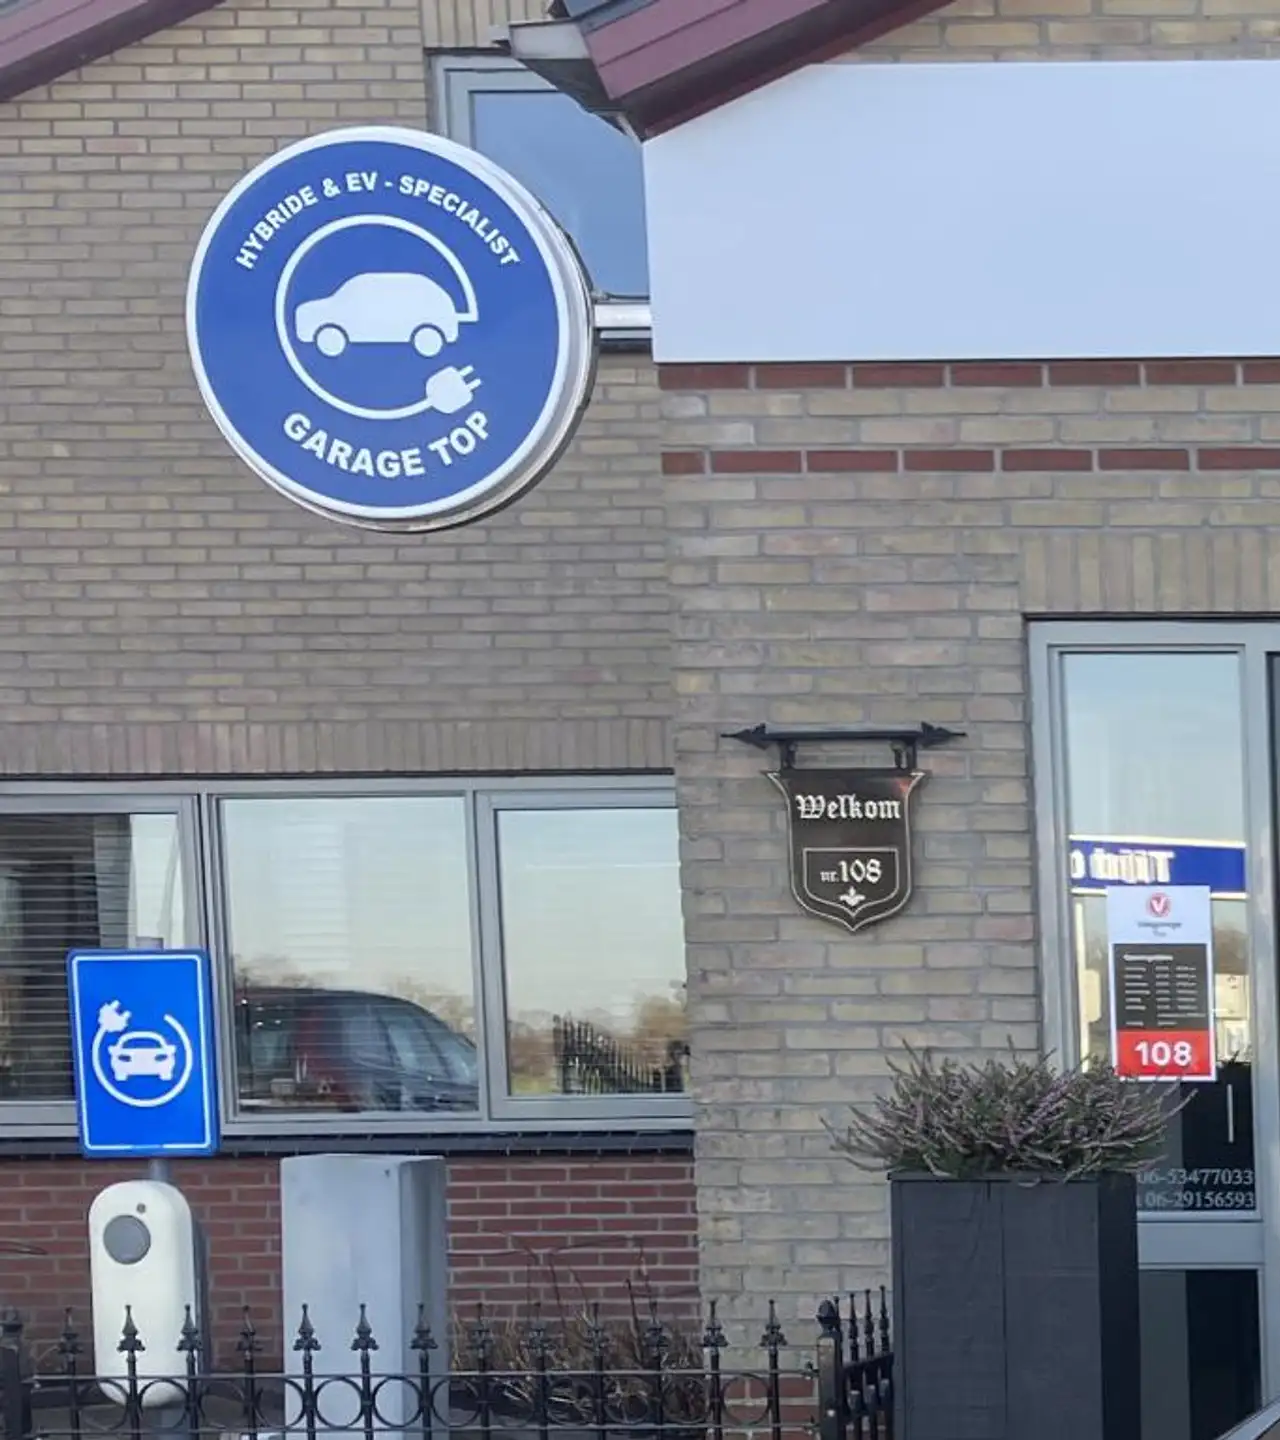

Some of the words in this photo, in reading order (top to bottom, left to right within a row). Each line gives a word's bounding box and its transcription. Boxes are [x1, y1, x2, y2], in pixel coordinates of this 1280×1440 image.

[235, 186, 318, 270] HYBRIDE
[322, 178, 340, 199] &
[345, 172, 378, 193] EV
[399, 175, 520, 268] SPECIALIST
[282, 413, 425, 479] GARAGE
[428, 411, 491, 467] TOP
[796, 794, 901, 820] Welkom
[839, 858, 882, 884] 108
[1134, 1040, 1192, 1067] 108
